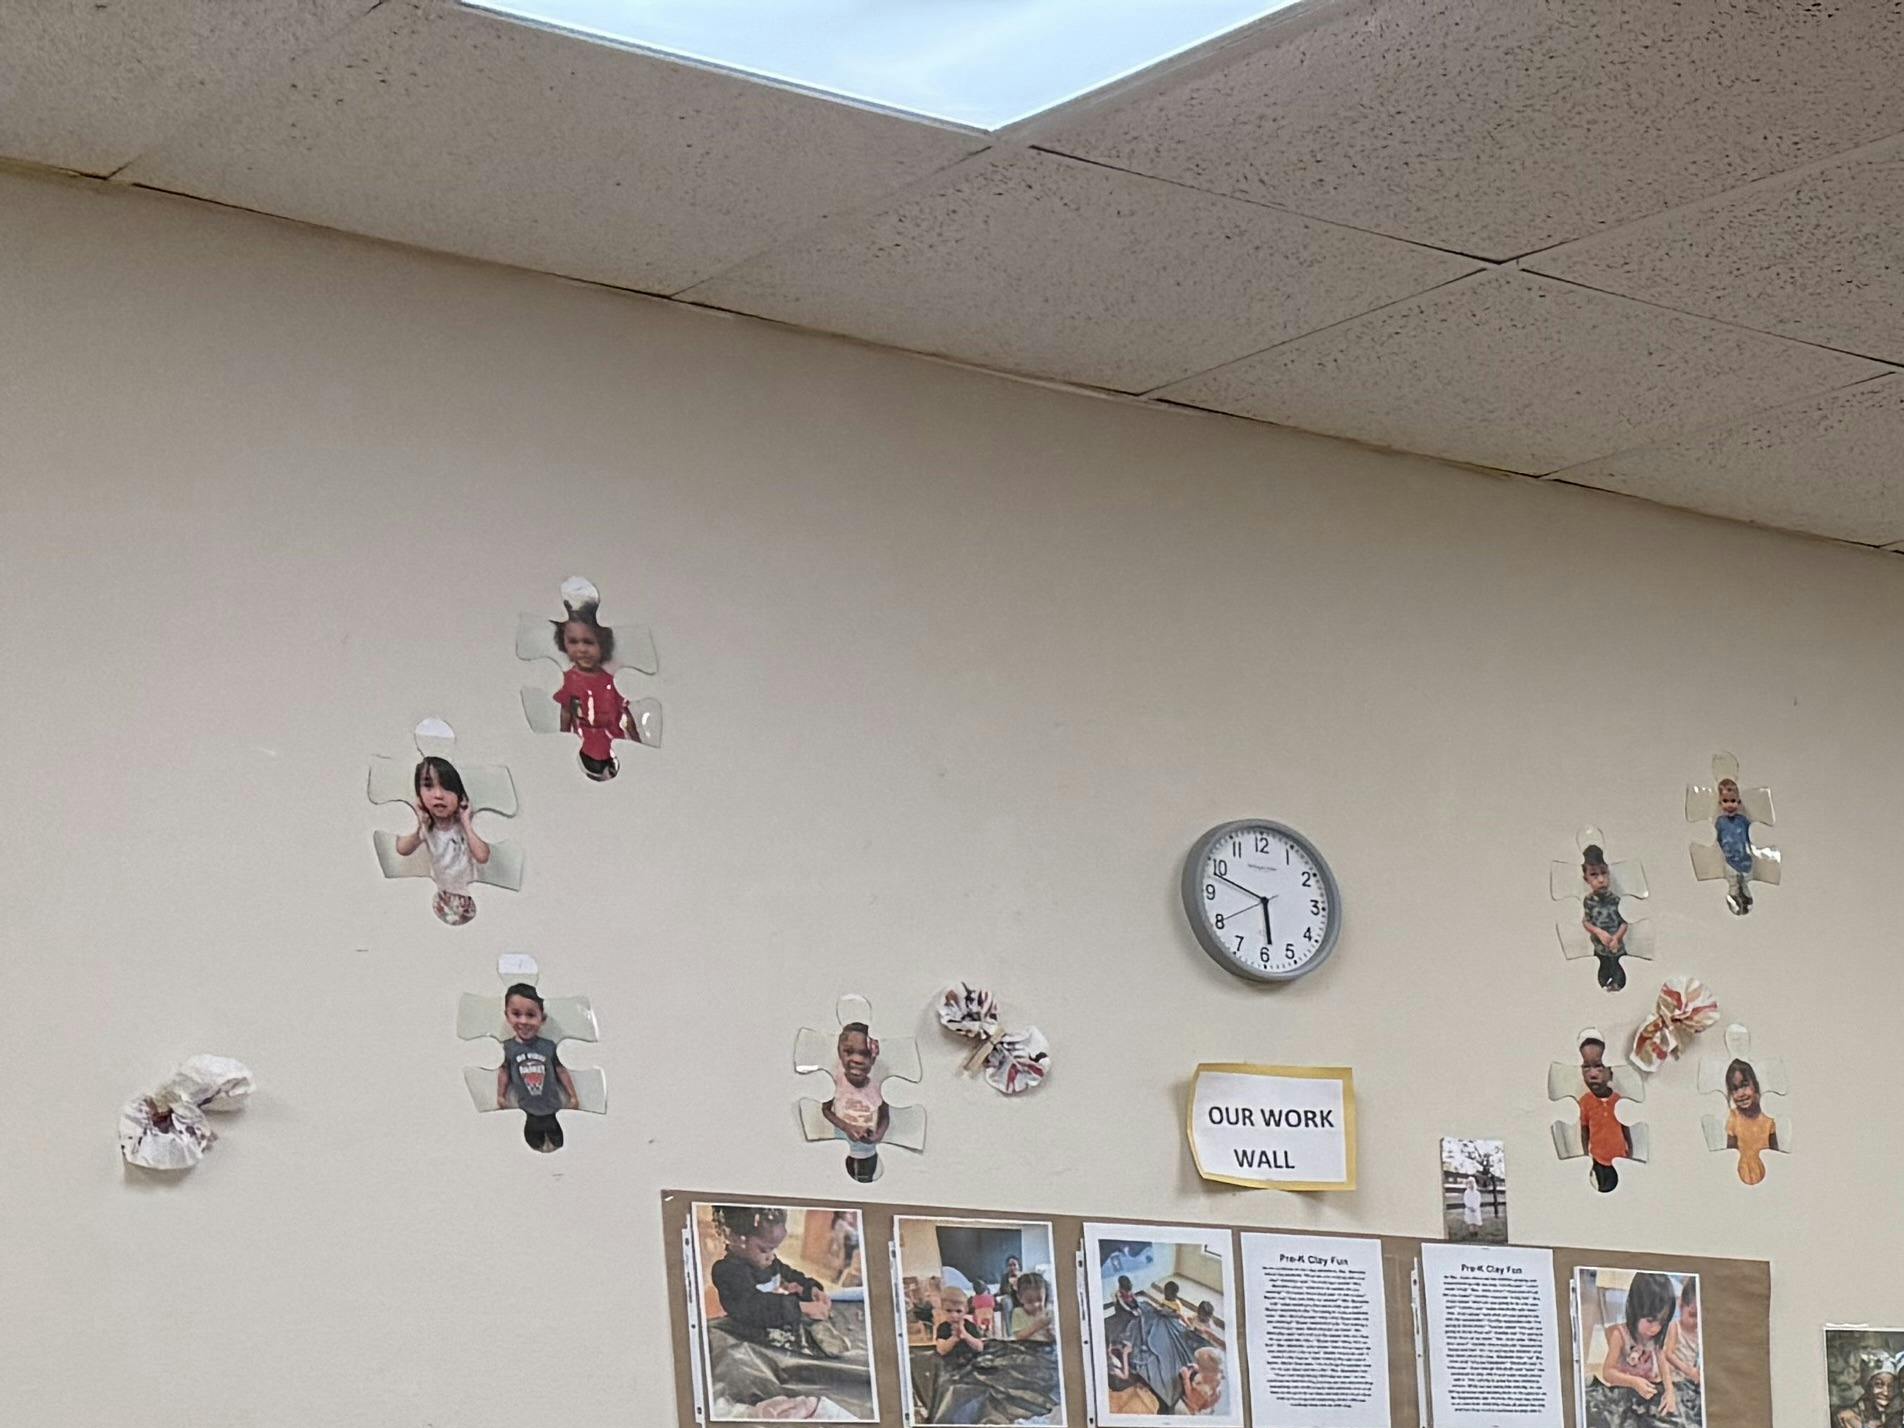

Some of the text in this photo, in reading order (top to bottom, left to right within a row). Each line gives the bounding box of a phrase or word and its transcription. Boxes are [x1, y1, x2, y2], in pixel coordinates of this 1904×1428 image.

[1232, 841, 1242, 858] 11
[1254, 836, 1270, 855] 12
[1285, 847, 1290, 866] 1
[1212, 858, 1228, 876] 10
[1301, 871, 1312, 888] 2
[1205, 884, 1216, 901] 9
[1309, 899, 1321, 916] 3
[1215, 913, 1225, 930] 8
[1303, 926, 1312, 942] 4
[1234, 935, 1244, 952] 7
[1285, 943, 1296, 960] 5
[1260, 946, 1270, 963] 6
[1208, 1105, 1335, 1128] OUR WORK
[1233, 1149, 1295, 1169] WALL
[1307, 1255, 1328, 1267] Clay
